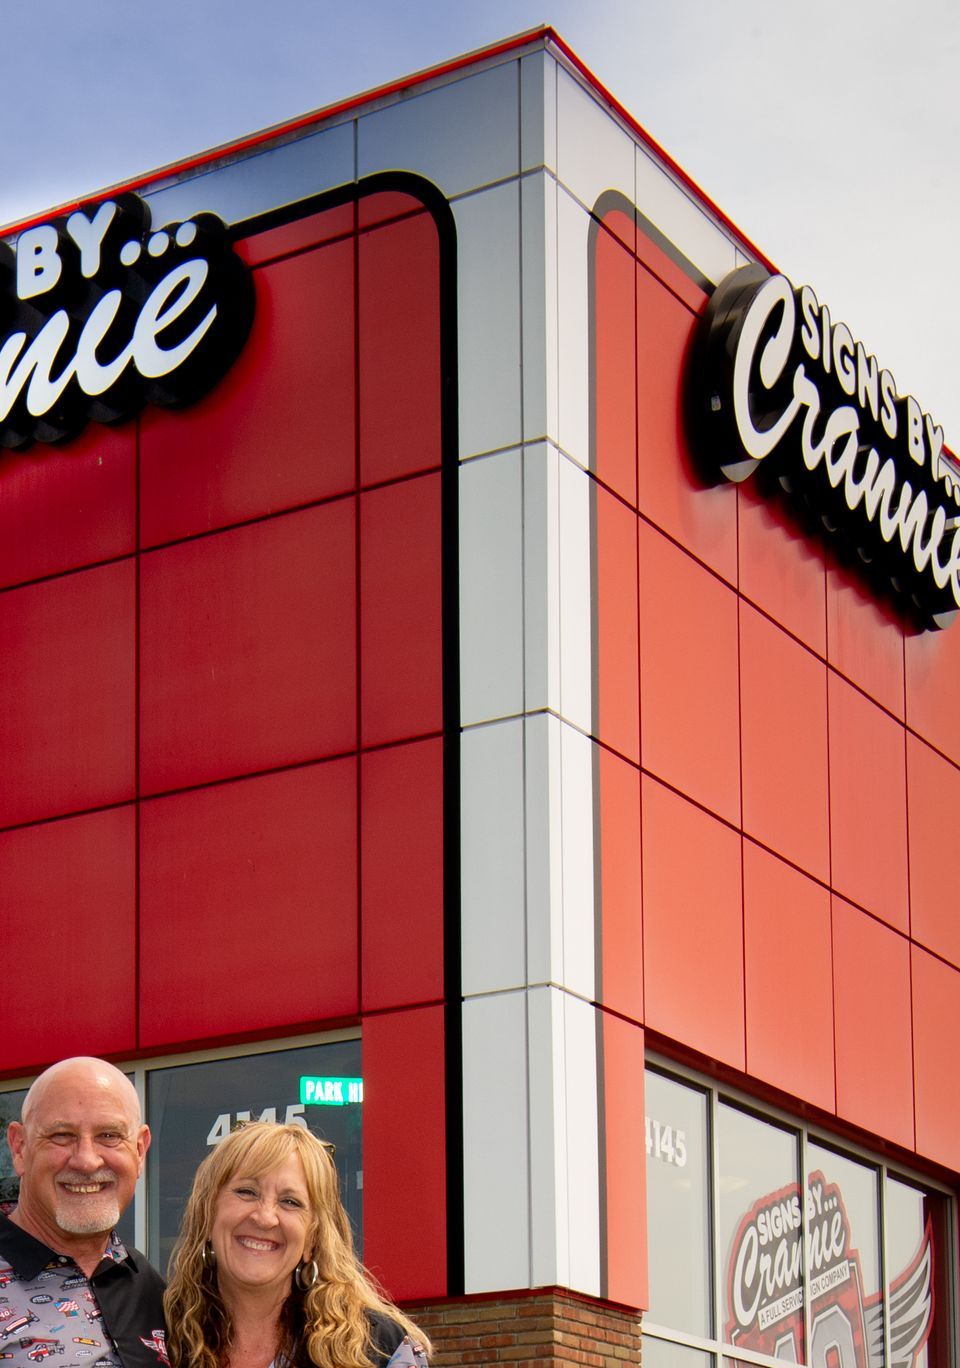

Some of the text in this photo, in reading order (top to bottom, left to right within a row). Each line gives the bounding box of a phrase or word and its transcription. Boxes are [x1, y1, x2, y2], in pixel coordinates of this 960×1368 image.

[16, 200, 197, 299] BY...
[801, 285, 898, 439] SIGNS
[305, 1080, 344, 1102] PARK
[757, 1196, 801, 1246] SIGNS
[761, 1263, 848, 1325] A FULL SERVIC IGN COMPANY
